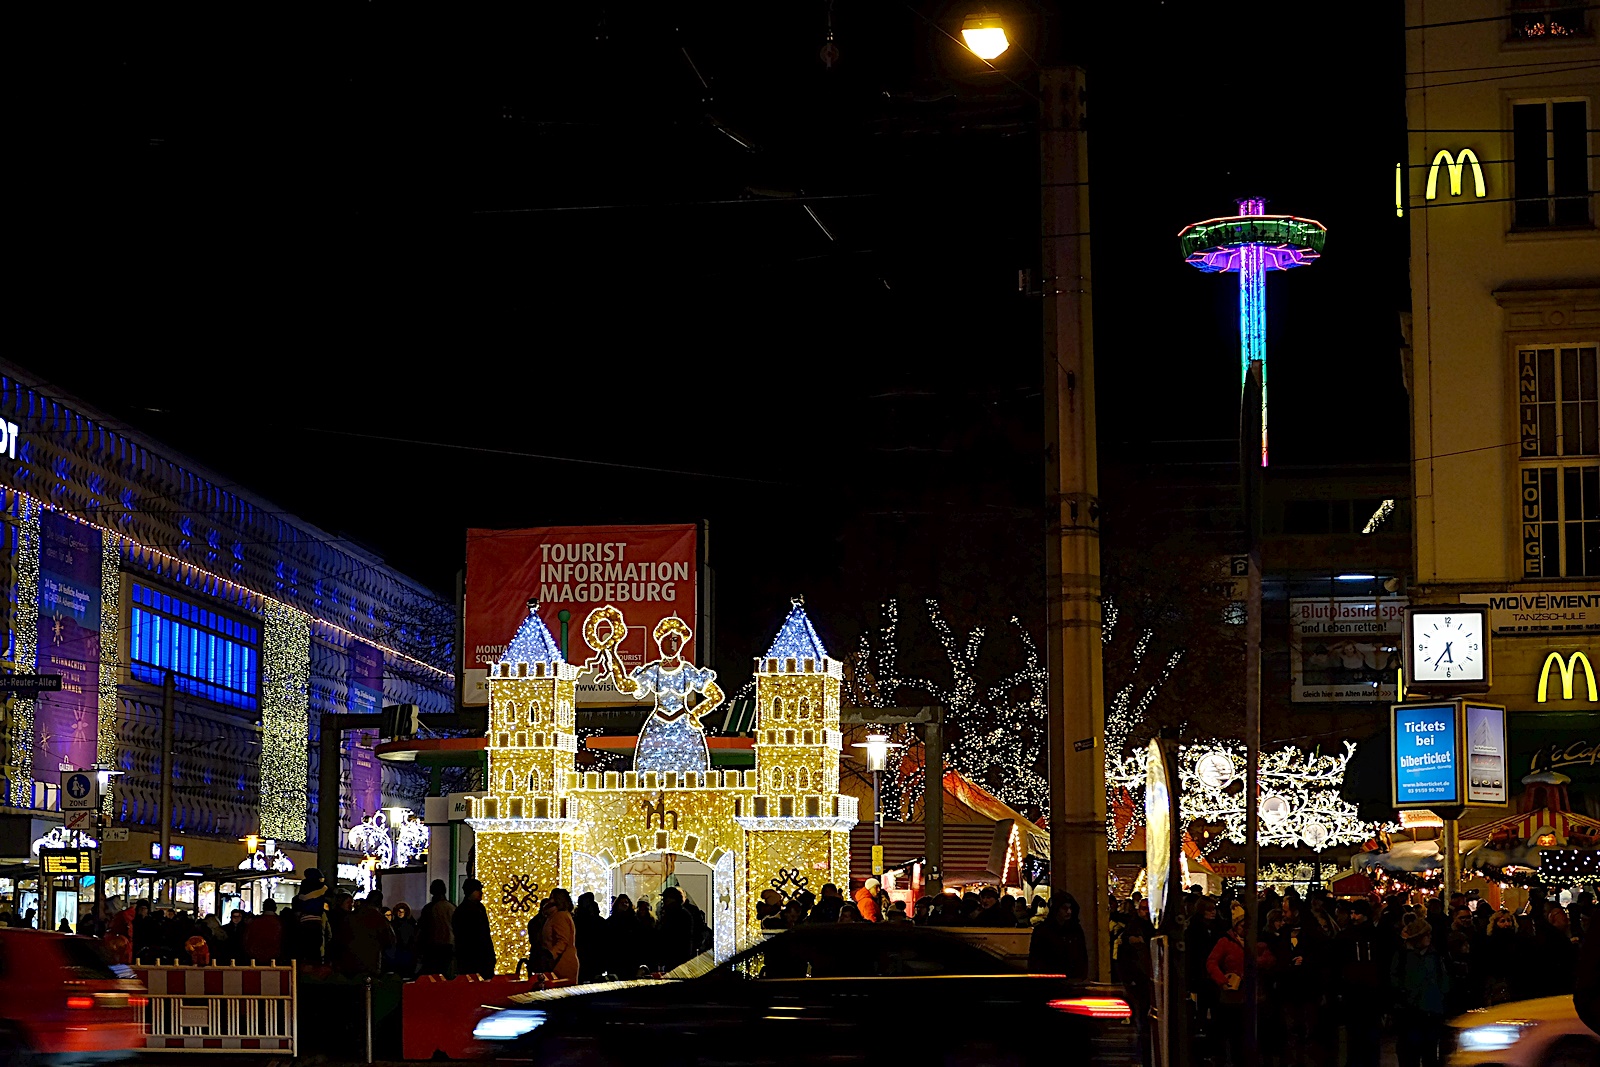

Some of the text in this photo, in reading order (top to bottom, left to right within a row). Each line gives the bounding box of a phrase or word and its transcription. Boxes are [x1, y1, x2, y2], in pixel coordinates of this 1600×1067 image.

[1520, 351, 1537, 451] TANNING
[1523, 470, 1540, 573] LOUNGE
[540, 542, 627, 563] TOURIST
[540, 562, 688, 583] INFORMATION
[539, 582, 676, 603] MAGDEBURG
[1301, 604, 1404, 621] Blutplasma spe
[1512, 612, 1586, 621] TANZSCHULE
[1444, 616, 1452, 625] 12
[1301, 622, 1388, 633] und Leben retten!
[1473, 643, 1479, 651] 3
[1446, 670, 1452, 678] 6
[1303, 690, 1320, 698] Gleich
[1321, 690, 1333, 698] hier
[1345, 690, 1361, 698] Alten
[1361, 690, 1379, 698] Markt
[1404, 720, 1446, 733] Tickets
[1415, 735, 1435, 746] bei
[1400, 751, 1451, 768] biberticket
[455, 803, 467, 812] Me
